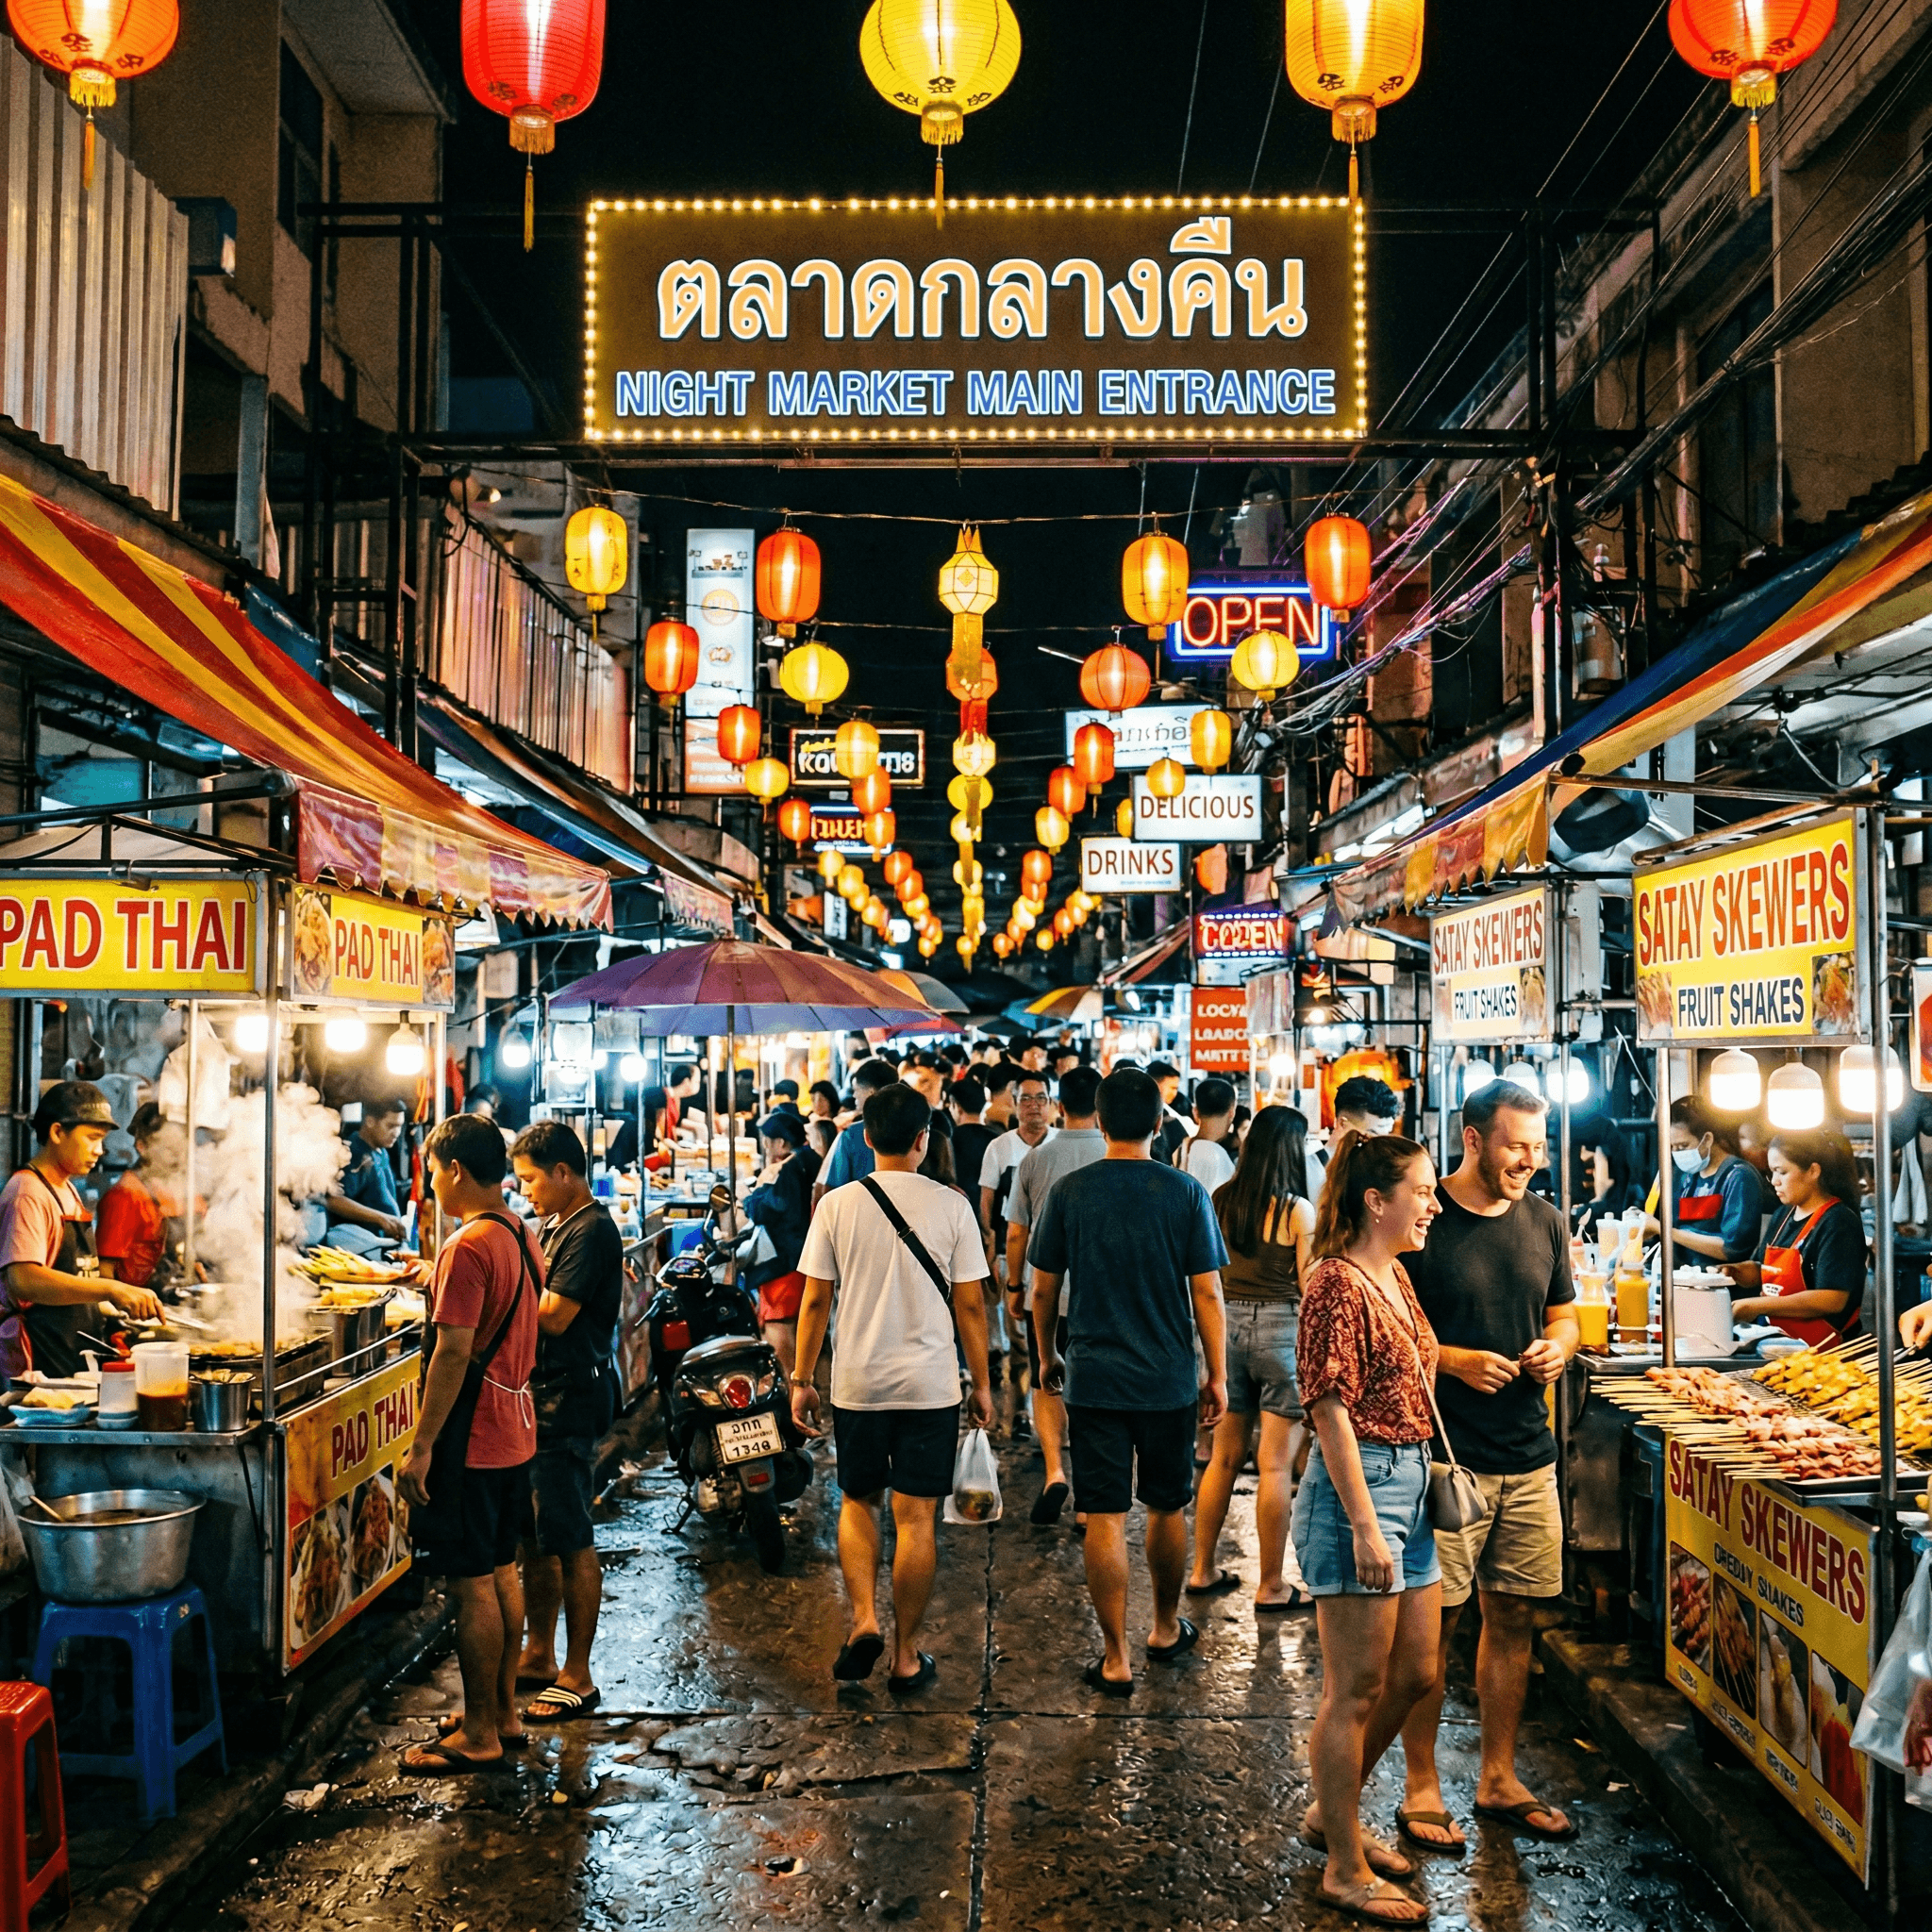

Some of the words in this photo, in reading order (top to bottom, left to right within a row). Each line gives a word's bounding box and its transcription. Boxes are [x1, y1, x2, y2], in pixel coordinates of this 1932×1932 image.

[658, 216, 1308, 341] ตลาดกลางคืน
[615, 369, 755, 418] NIGHT
[768, 369, 953, 418] MARKET
[967, 369, 1082, 417] MAIN
[1098, 368, 1336, 416] ENTRANCE
[1182, 595, 1321, 647] OPEN
[1140, 794, 1255, 819] DELICIOUS
[1088, 848, 1174, 875] DRINKS
[0, 898, 104, 971] PAD
[116, 897, 248, 974] THAI
[1433, 921, 1471, 975] SATAY
[1473, 899, 1543, 971] SKEWERS
[1638, 877, 1707, 967] SATAY
[1711, 841, 1852, 957] SKEWERS
[333, 918, 375, 980] PAD
[377, 926, 420, 987] THAI
[1454, 989, 1479, 1021] FRUIT
[1480, 984, 1518, 1019] SHAKES
[1677, 984, 1724, 1027] FRUIT
[1729, 977, 1805, 1024] SHAKES
[331, 1408, 369, 1480] PAD
[374, 1380, 414, 1451] THAI
[1669, 1441, 1734, 1532] SATAY
[1740, 1481, 1867, 1626] SKEWERS
